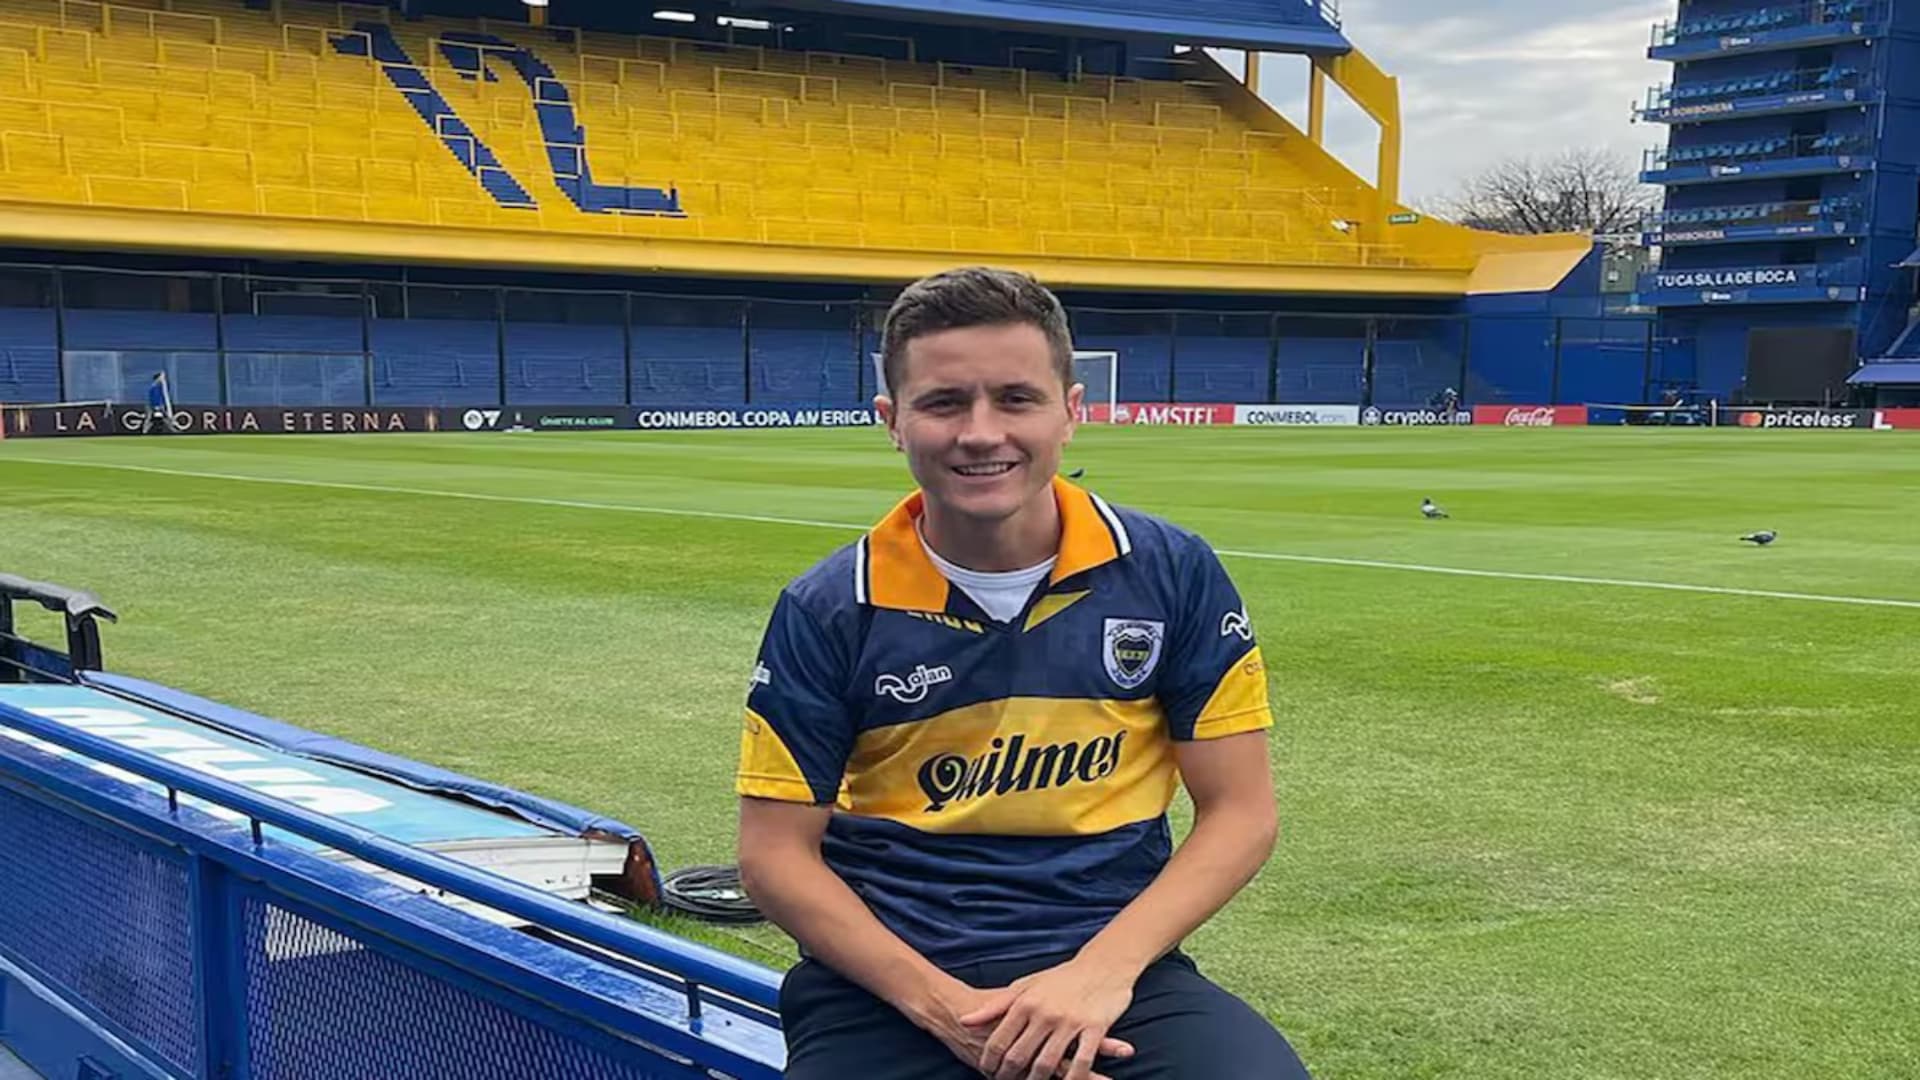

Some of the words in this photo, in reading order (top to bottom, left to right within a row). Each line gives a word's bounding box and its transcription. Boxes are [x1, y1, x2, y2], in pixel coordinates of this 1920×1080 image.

[328, 21, 688, 217] 12
[1657, 275, 1675, 287] TU
[1716, 272, 1733, 285] LA
[1735, 271, 1753, 284] DE
[1755, 270, 1796, 284] BOCA
[55, 411, 96, 431] LA
[122, 411, 260, 431] GORIA
[283, 412, 405, 431] ETERNA
[638, 410, 742, 428] CONMEBOL
[743, 410, 791, 427] COPA
[793, 409, 871, 427] AMERICA
[1763, 410, 1853, 429] priceless
[917, 730, 1128, 813] Quilmes
